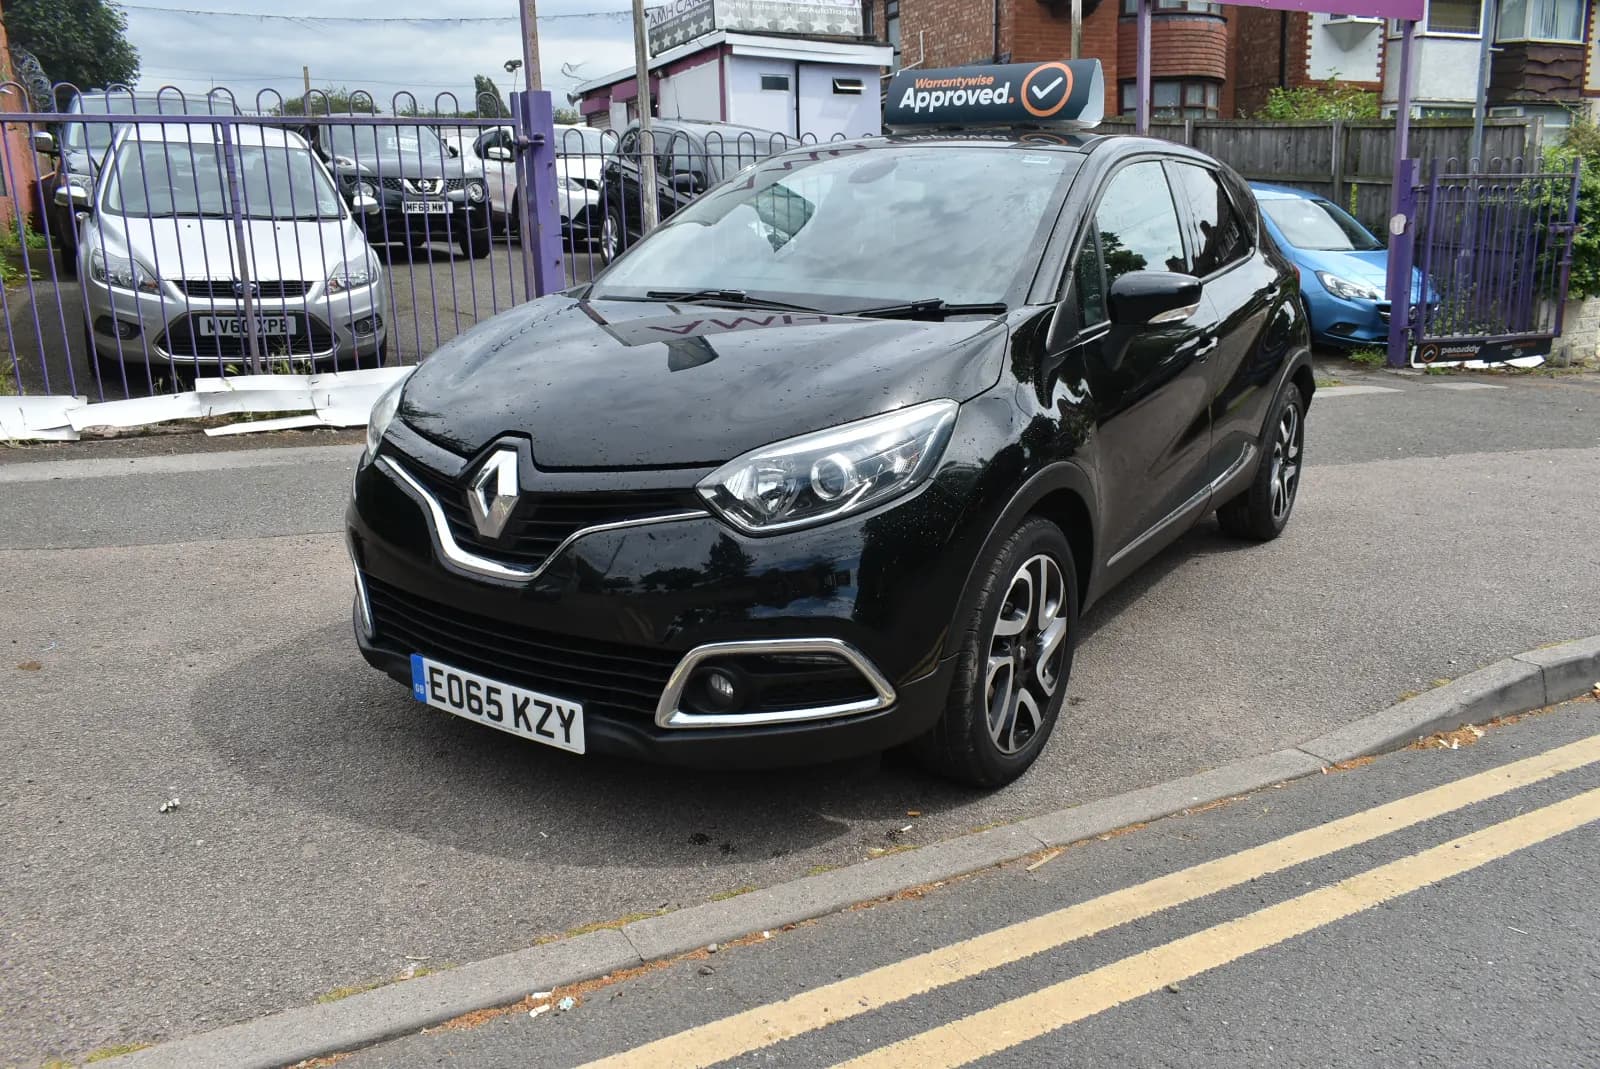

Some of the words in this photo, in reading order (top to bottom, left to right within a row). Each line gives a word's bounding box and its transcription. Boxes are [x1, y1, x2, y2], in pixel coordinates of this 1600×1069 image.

[649, 4, 674, 27] AMH
[915, 74, 995, 89] Warrantywise
[512, 692, 575, 744] KZY
